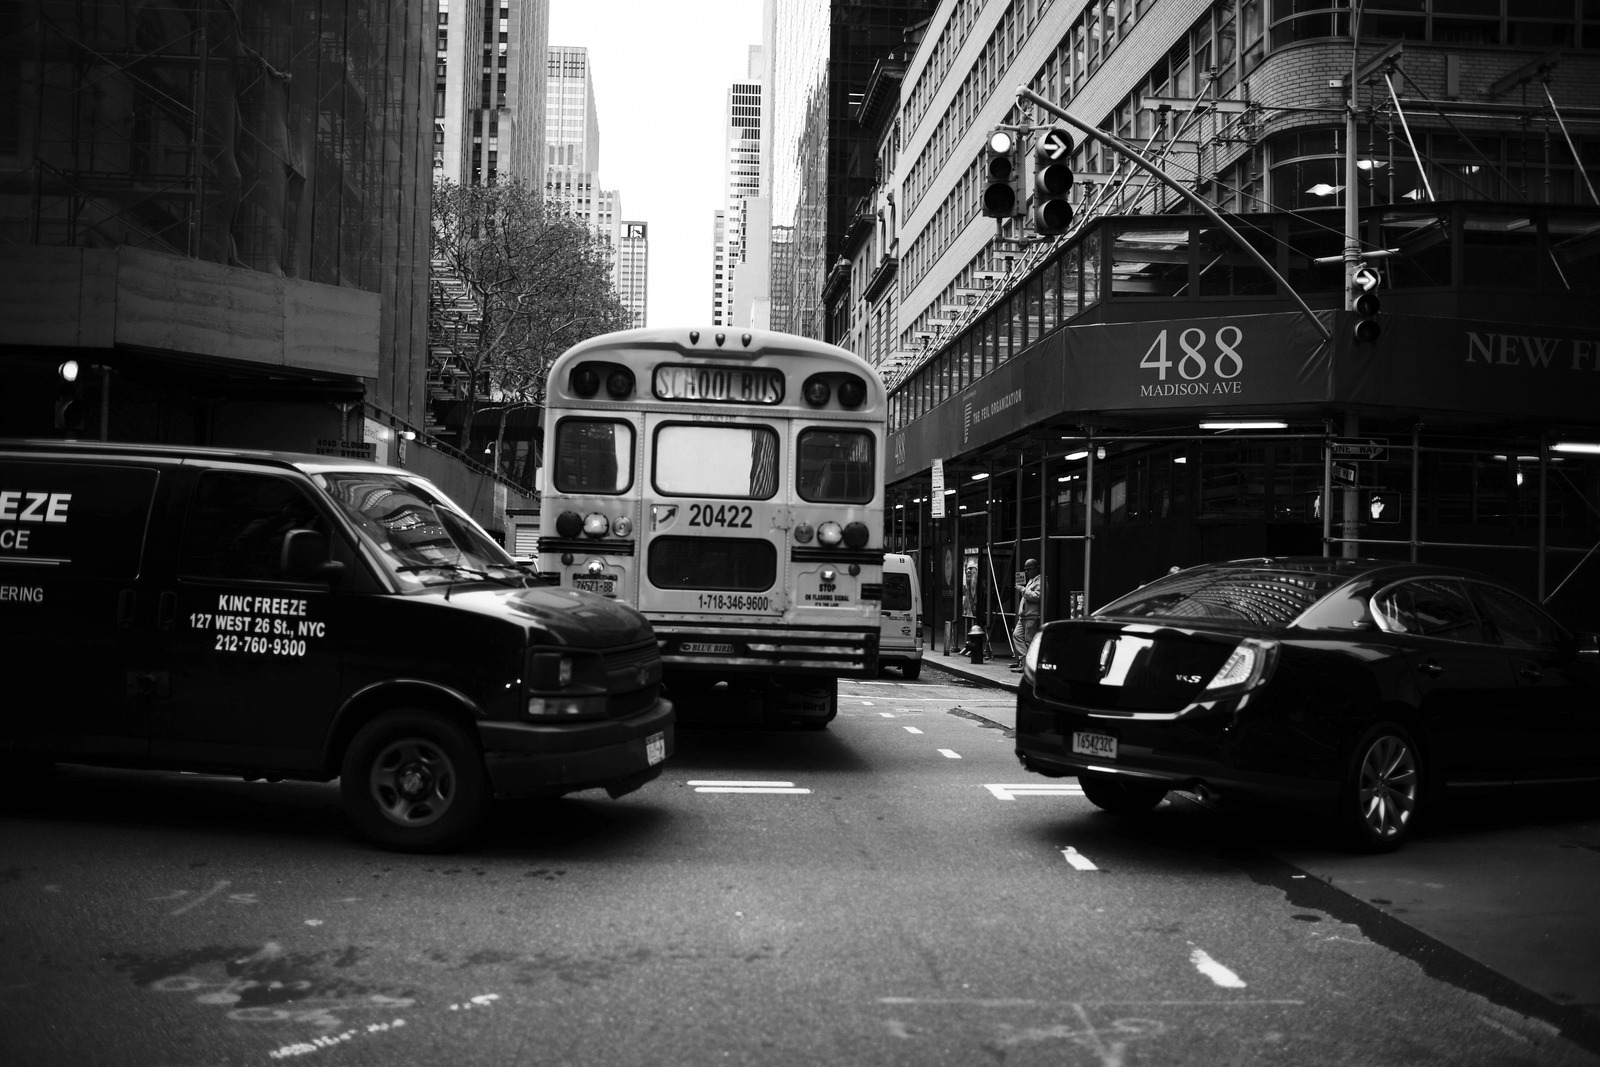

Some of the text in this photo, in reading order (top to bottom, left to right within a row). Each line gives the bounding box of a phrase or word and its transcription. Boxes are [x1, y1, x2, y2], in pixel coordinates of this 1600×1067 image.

[1140, 326, 1243, 380] 488
[1465, 331, 1562, 368] NEW
[658, 367, 780, 400] SCHOOL BUS
[1140, 381, 1242, 396] MADISON AVE
[341, 441, 371, 450] CLOSED
[341, 449, 371, 458] STREET
[0, 491, 72, 523] EZE
[689, 504, 753, 528] 20422
[0, 529, 30, 549] CE
[0, 586, 44, 602] ERING
[819, 583, 836, 592] STOP
[254, 597, 308, 616] FREEZE
[698, 594, 769, 611] 1-718-346-9600
[190, 613, 212, 629] 127
[215, 615, 252, 632] WEST
[254, 618, 270, 633] 26
[298, 621, 326, 638] NYC
